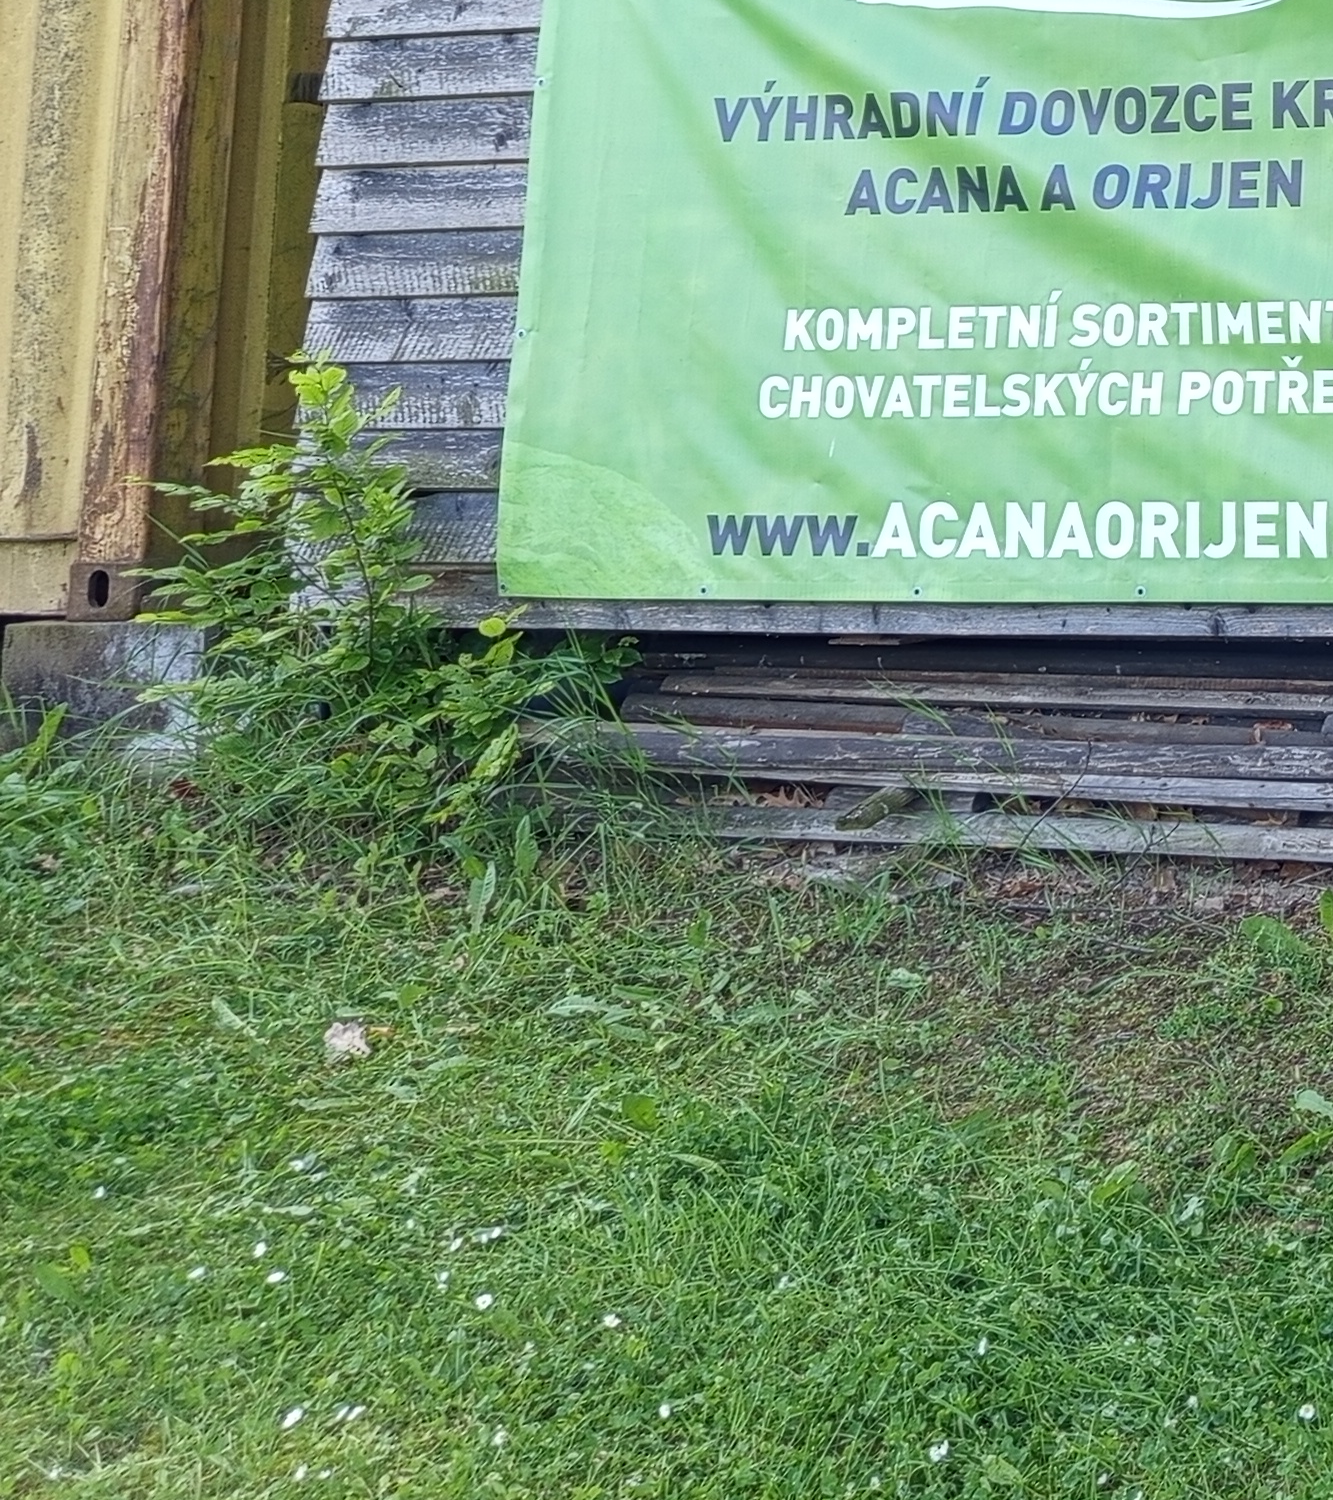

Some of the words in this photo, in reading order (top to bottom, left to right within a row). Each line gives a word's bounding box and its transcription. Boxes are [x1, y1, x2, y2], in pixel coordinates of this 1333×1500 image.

[714, 74, 990, 143] VÝHRADNÍ
[998, 79, 1254, 137] DOVOZCE
[845, 165, 1029, 217] ACANA
[1040, 163, 1076, 211] A
[1091, 158, 1304, 211] ORIJEN
[782, 289, 1063, 352] KOMPLETNÍ
[757, 358, 1164, 420] CHOVATELSKÝCH
